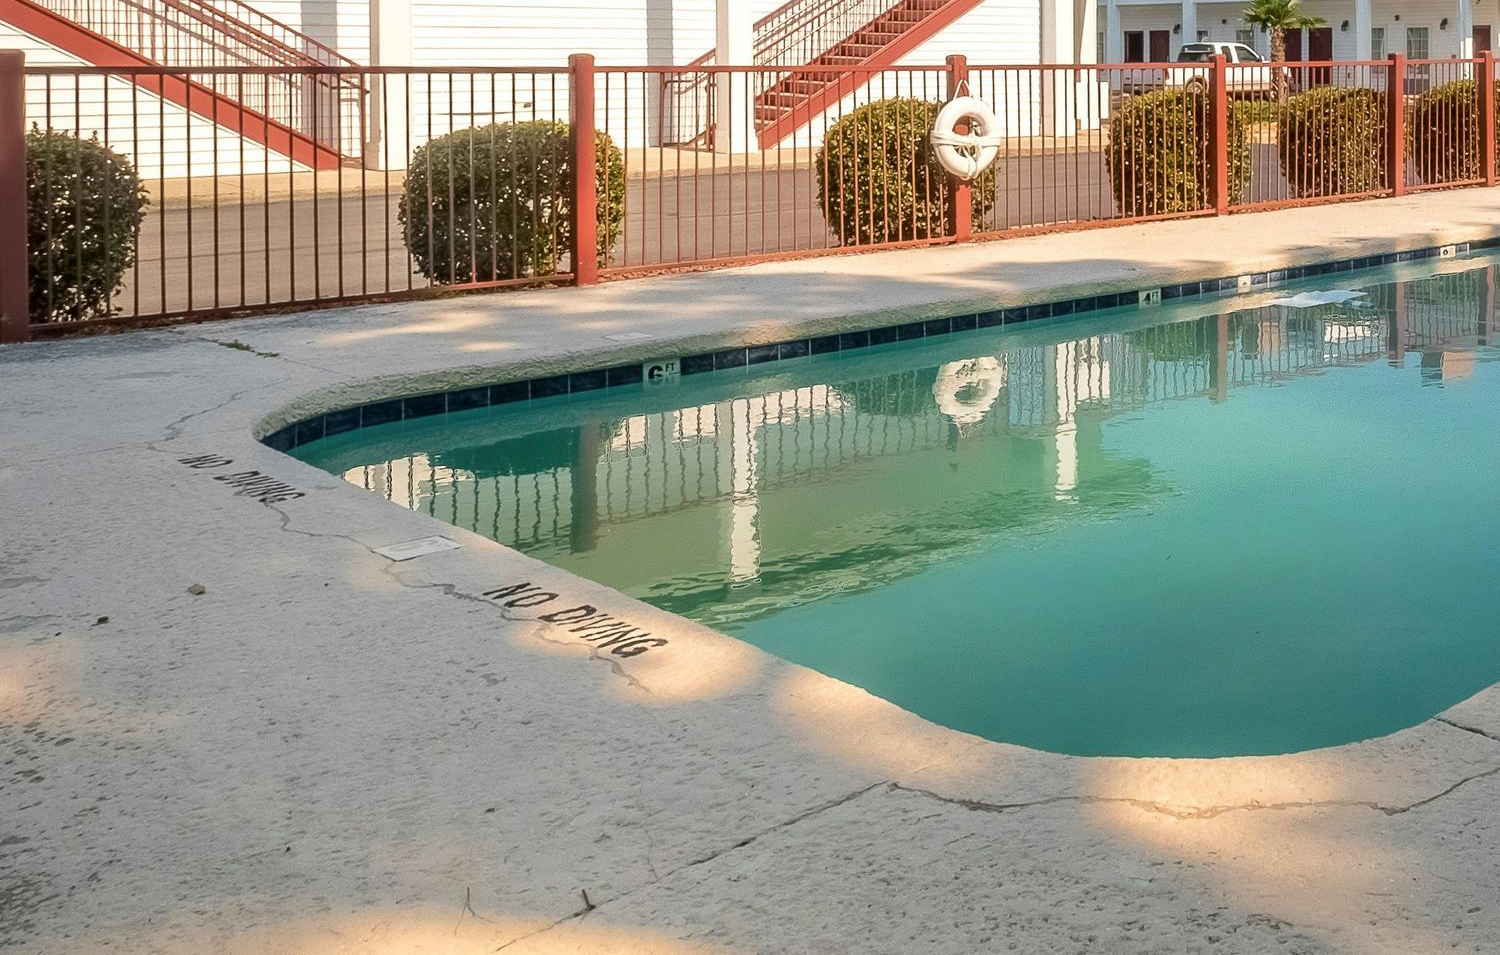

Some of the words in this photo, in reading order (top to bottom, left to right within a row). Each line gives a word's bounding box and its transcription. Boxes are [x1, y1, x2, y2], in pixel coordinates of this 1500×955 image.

[665, 362, 676, 373] FT
[177, 453, 234, 469] NO
[213, 470, 306, 504] DIVING
[482, 582, 560, 608] NO
[537, 604, 669, 659] DIVING
